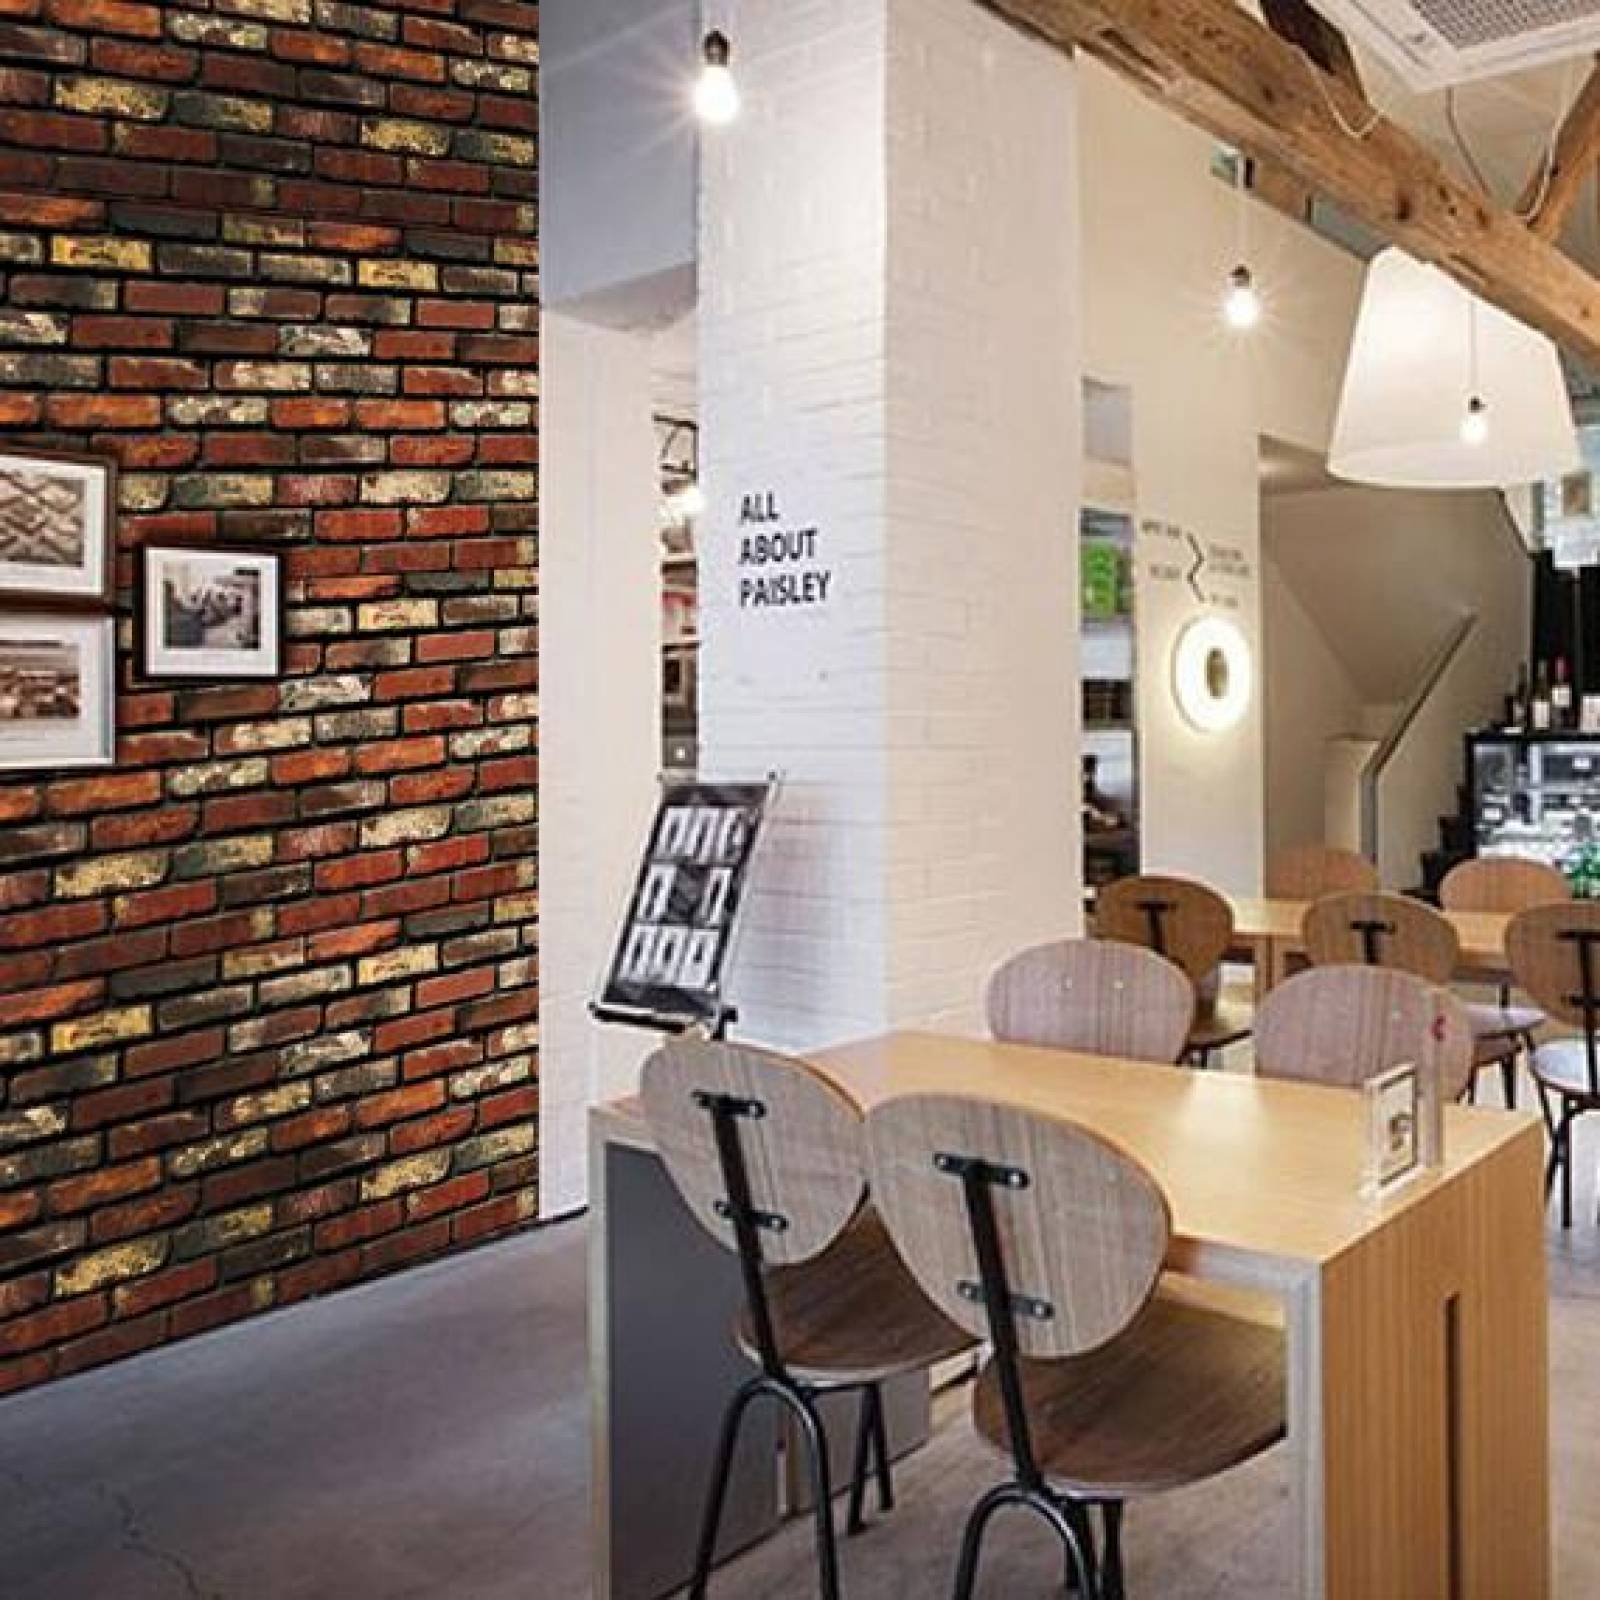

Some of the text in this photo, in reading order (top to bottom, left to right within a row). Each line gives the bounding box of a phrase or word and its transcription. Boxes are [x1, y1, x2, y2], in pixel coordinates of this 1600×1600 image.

[739, 491, 780, 525] ALL
[738, 528, 818, 565] ABOUT
[739, 570, 832, 607] PAISLEY
